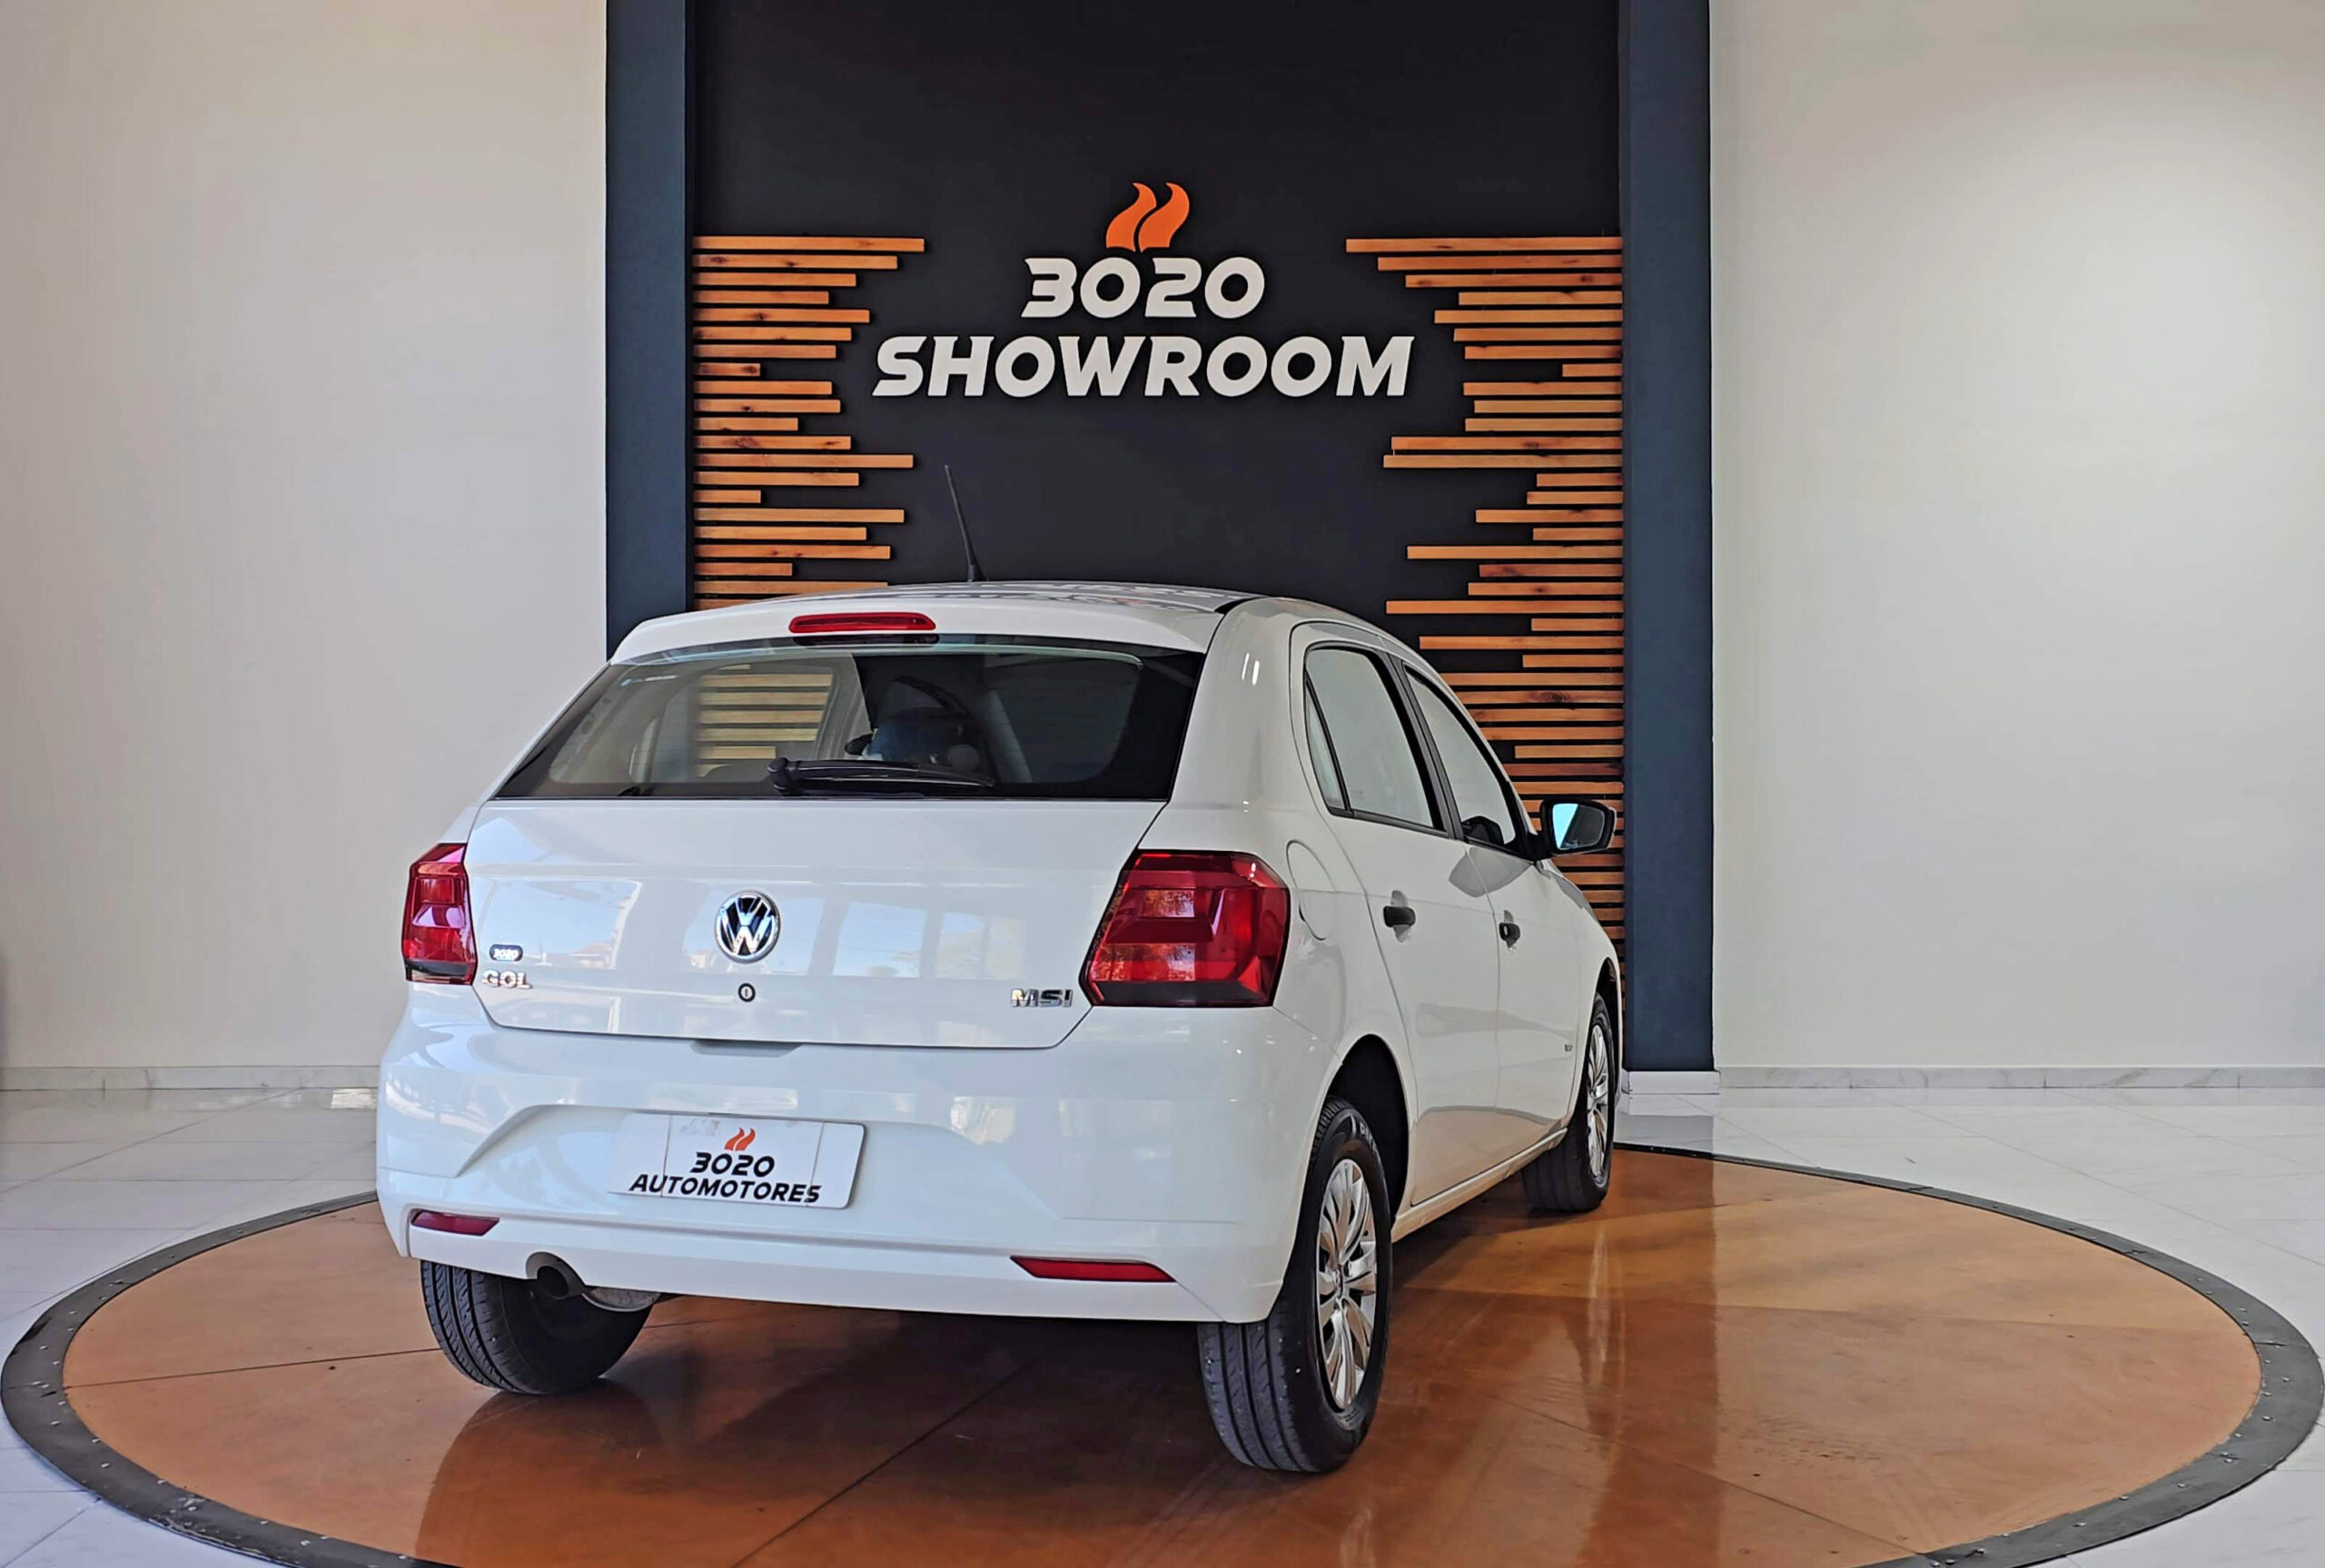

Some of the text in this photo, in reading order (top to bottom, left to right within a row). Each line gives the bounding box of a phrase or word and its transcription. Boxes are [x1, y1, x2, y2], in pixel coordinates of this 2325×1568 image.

[1021, 256, 1265, 319] 3020
[872, 335, 1415, 398] SHOWROOM
[481, 970, 533, 989] GOL
[1011, 988, 1073, 1008] MSI
[690, 1151, 775, 1178] 3020
[628, 1173, 822, 1204] AUTOMOTORES
